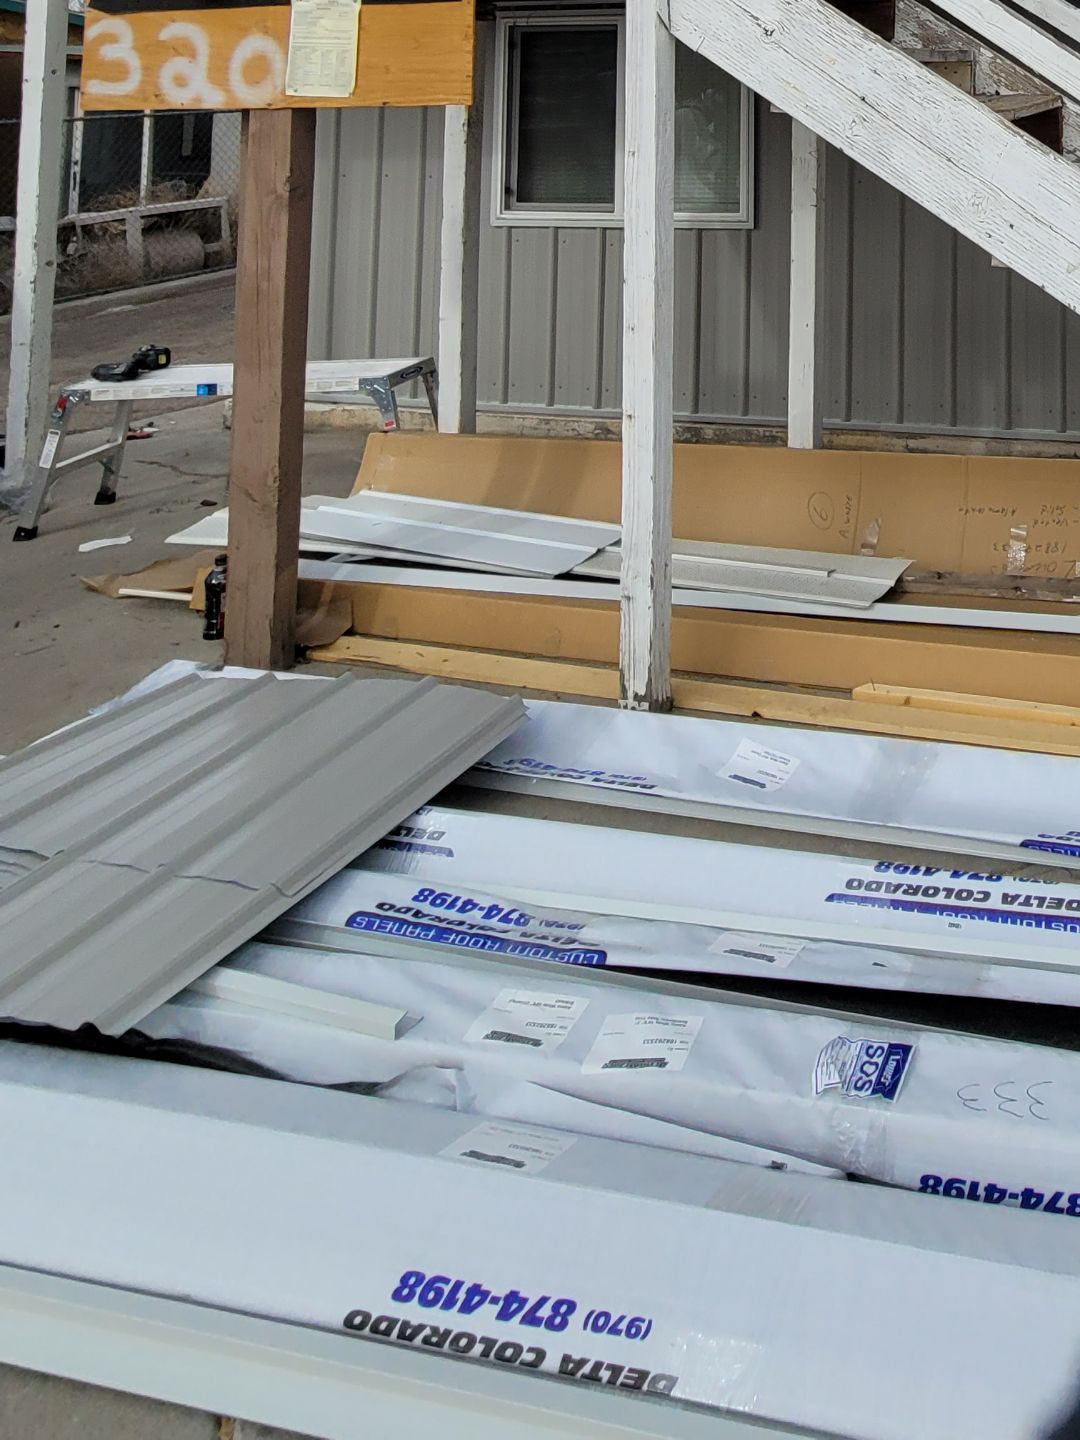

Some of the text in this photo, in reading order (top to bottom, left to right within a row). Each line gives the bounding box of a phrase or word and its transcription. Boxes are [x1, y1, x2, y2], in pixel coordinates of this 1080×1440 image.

[85, 17, 286, 105] 320
[410, 887, 536, 927] 874-4198
[844, 878, 992, 903] COLORADO
[352, 915, 600, 965] CUSTOM ROOF PANELS
[853, 1045, 885, 1092] SOS
[956, 1081, 1054, 1121] 333
[391, 1270, 653, 1341] (970) 874-4198
[342, 1309, 680, 1396] DELTA COLORADO
